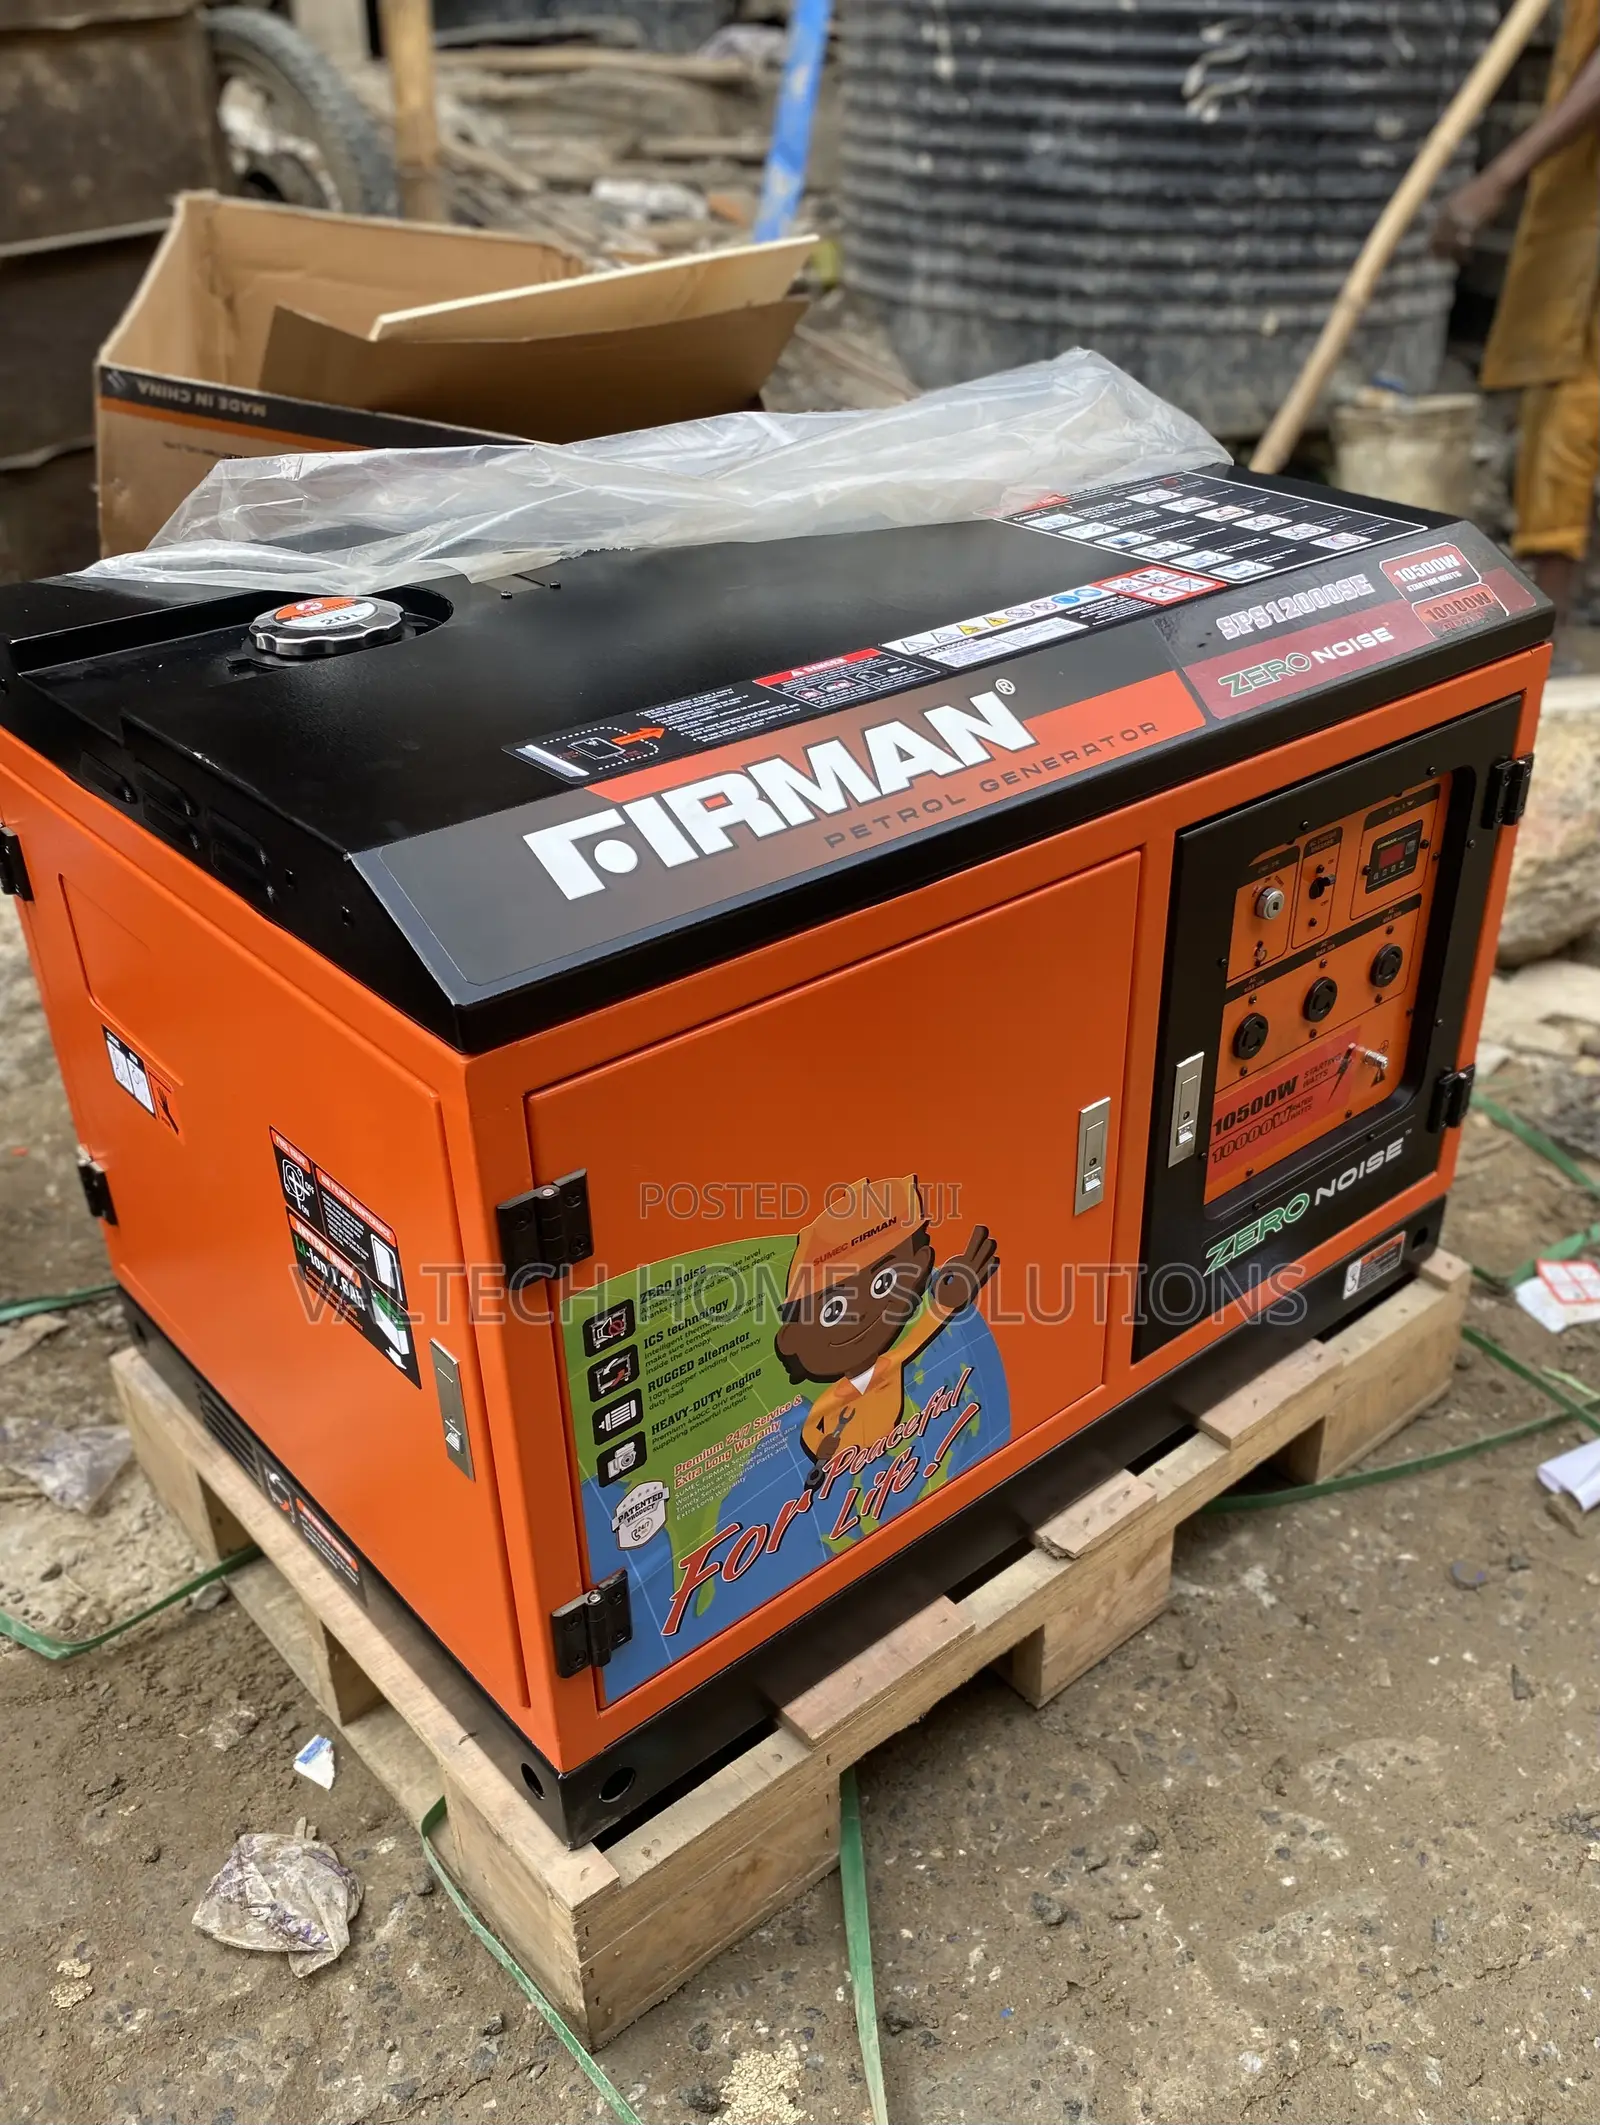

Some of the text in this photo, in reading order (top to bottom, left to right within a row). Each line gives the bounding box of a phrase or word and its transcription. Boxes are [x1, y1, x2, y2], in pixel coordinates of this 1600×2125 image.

[136, 378, 267, 418] MADE IN CHINA
[1393, 553, 1461, 583] 10500W
[1215, 573, 1377, 641] SPS12000SE
[1423, 591, 1493, 621] 10000W
[1217, 626, 1395, 698] ZERO NOISE
[523, 690, 1037, 900] FIRMAN
[824, 720, 1160, 849] PETROL GENERATOR
[1303, 1069, 1329, 1089] WATTS
[1213, 1074, 1299, 1137] 10500W
[1212, 1104, 1292, 1164] 10000W
[1203, 1192, 1310, 1278] ZERO
[1314, 1137, 1405, 1206] NOISE
[744, 1248, 761, 1262] level
[813, 1216, 897, 1267] SUMEC FIRMAN
[640, 1265, 707, 1304] ZERO noise
[641, 1306, 669, 1323] thanks
[644, 1298, 729, 1349] ICS technology
[645, 1335, 683, 1360] Intelligent
[645, 1352, 667, 1367] make
[669, 1343, 685, 1355] sure
[646, 1360, 669, 1376] inside
[670, 1352, 683, 1362] the
[648, 1331, 750, 1394] RUGGED alternator
[649, 1337, 761, 1402] 100% copper winding for heavy
[649, 1387, 684, 1411] duty load
[652, 1367, 762, 1436] HEAVY-DUTY engine
[652, 1420, 686, 1445] Premium
[712, 1397, 729, 1411] OHV
[729, 1384, 754, 1403] engine
[653, 1430, 688, 1453] supplying
[690, 1409, 722, 1431] powerful
[674, 1394, 804, 1476] Premium 24/7 Service &
[774, 1444, 788, 1455] and
[674, 1420, 782, 1490] Extra Long Warranty
[675, 1481, 700, 1500] SUMEC
[702, 1463, 730, 1483] FIRMAN
[783, 1424, 798, 1436] and
[617, 1491, 664, 1524] PATENTED
[626, 1502, 656, 1523] PRODUCT
[661, 1367, 973, 1637] For Peaceful
[676, 1506, 696, 1521] Extra
[637, 1520, 650, 1532] 24/7
